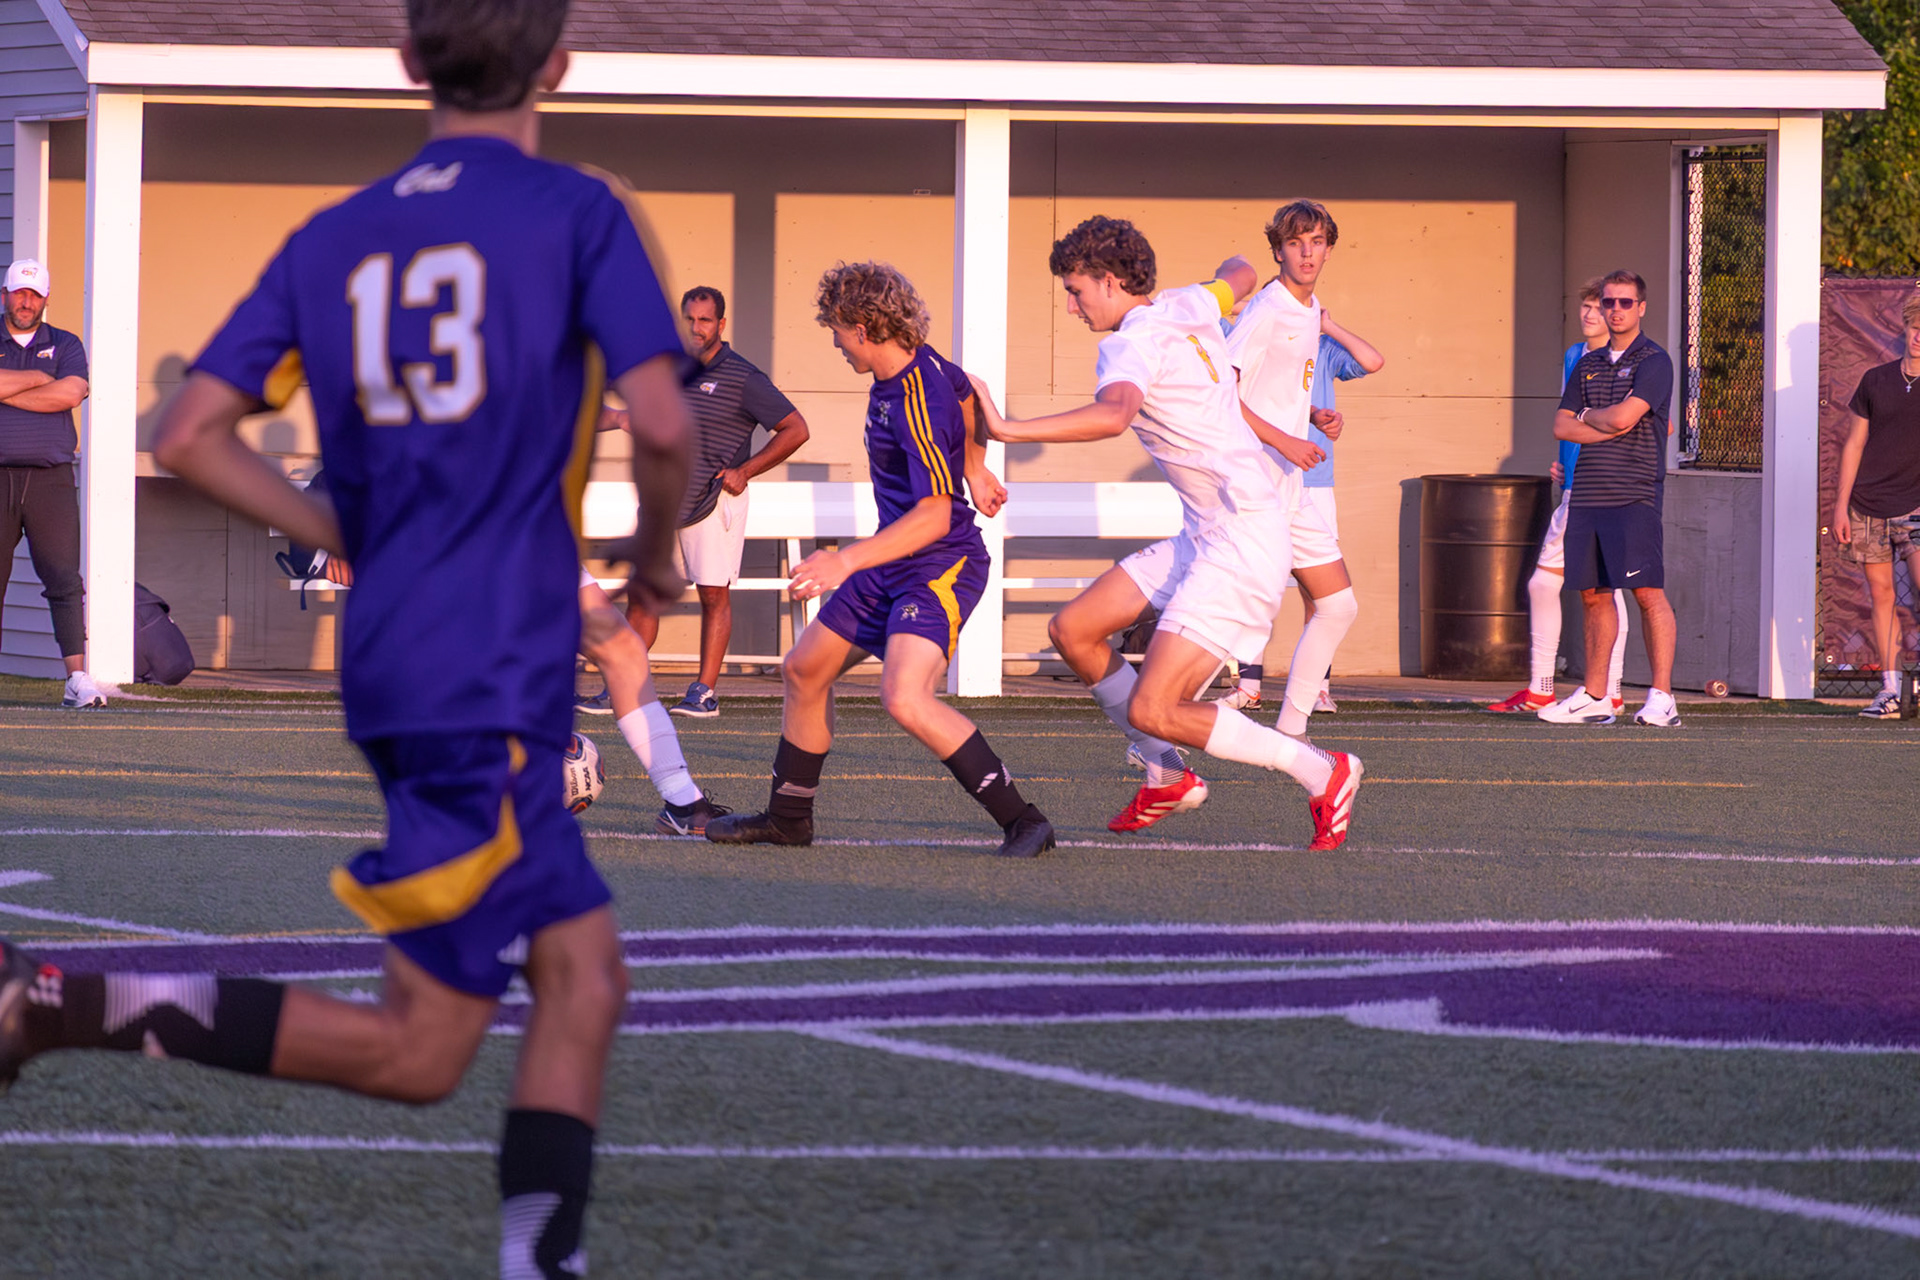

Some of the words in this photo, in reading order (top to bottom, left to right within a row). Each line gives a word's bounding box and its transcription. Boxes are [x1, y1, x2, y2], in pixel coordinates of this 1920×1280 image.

[346, 241, 487, 426] 13
[1303, 358, 1315, 392] 6
[570, 767, 579, 796] Wilson
[583, 767, 591, 791] NCAA
